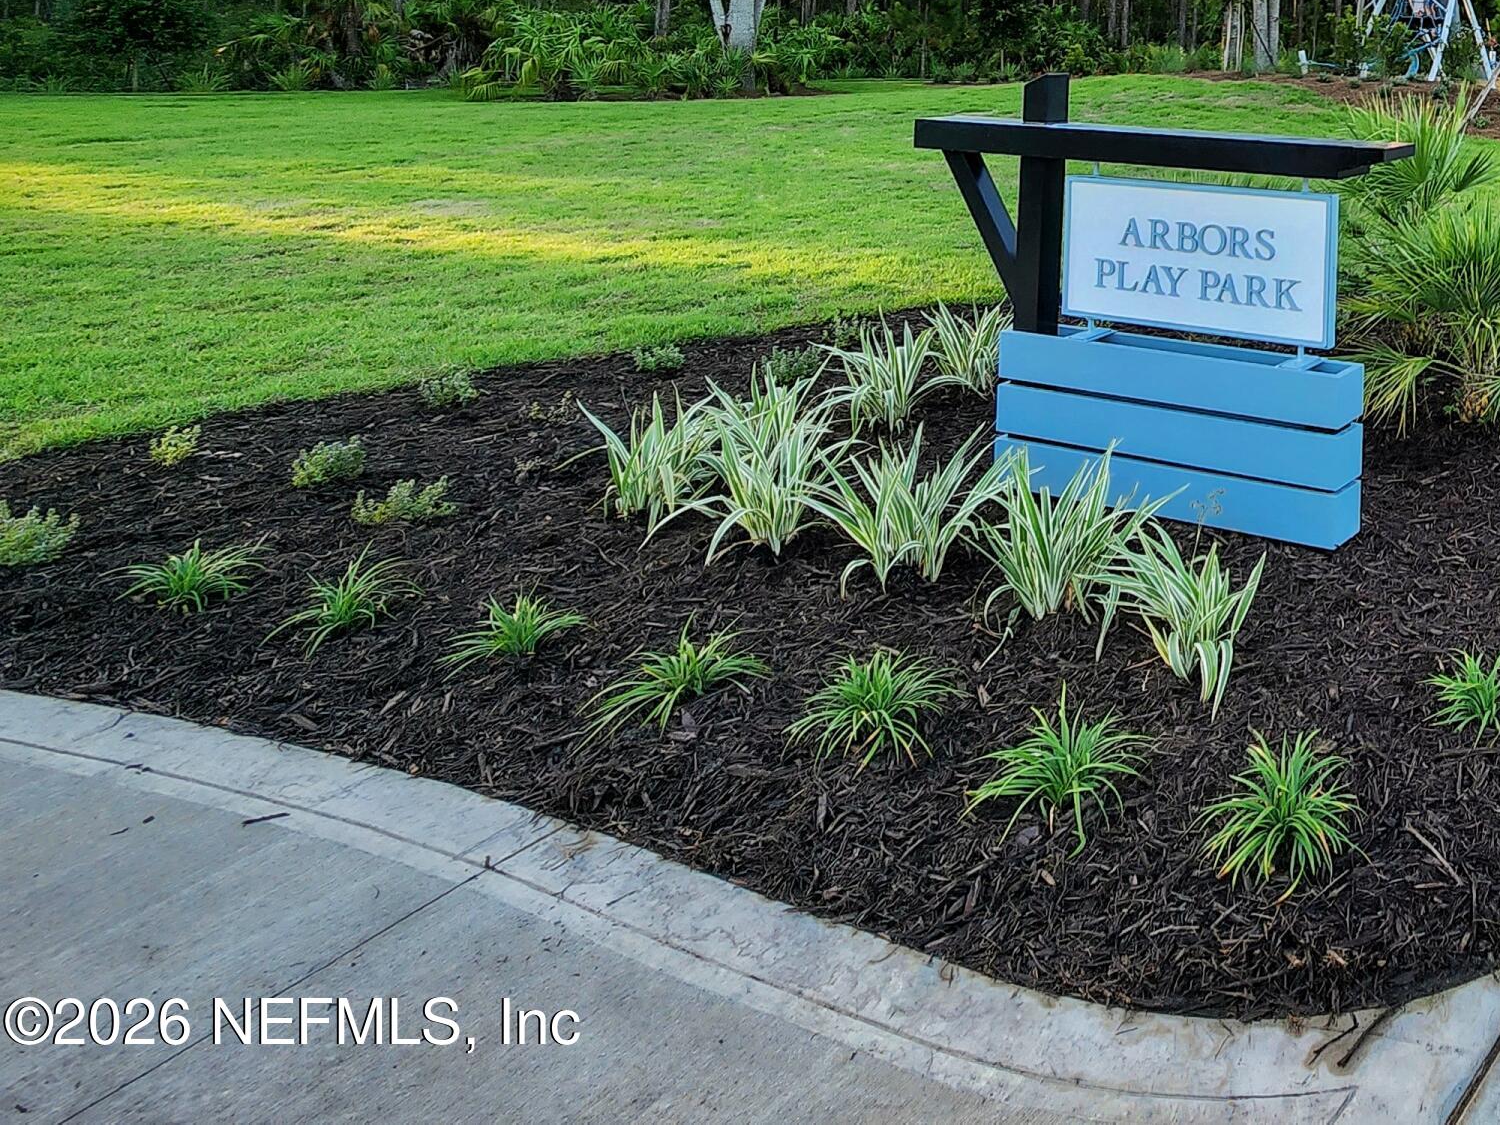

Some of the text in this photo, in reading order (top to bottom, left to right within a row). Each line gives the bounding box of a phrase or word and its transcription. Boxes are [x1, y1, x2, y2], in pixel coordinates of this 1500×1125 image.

[1118, 217, 1277, 261] ARBORS
[1094, 257, 1303, 312] PLAY PARK
